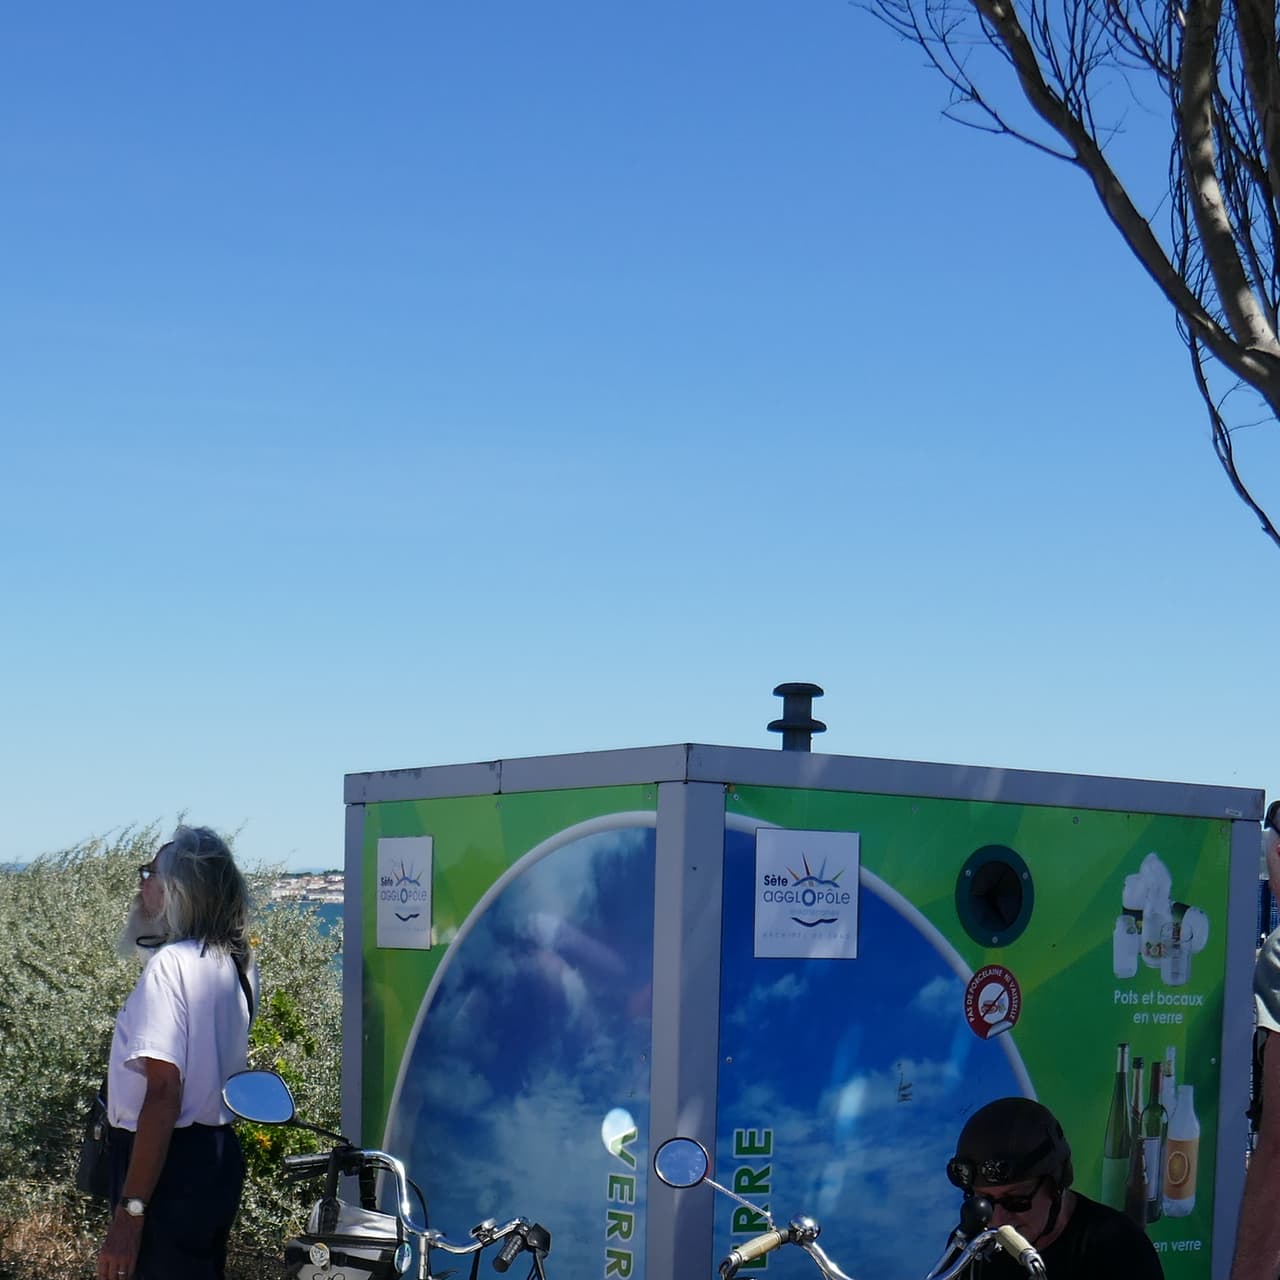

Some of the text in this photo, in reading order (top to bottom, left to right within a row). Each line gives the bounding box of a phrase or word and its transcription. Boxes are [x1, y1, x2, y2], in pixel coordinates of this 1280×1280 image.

[763, 874, 788, 887] Sète
[1114, 990, 1204, 1006] Pots et bocaux
[1133, 1013, 1184, 1024] en verre
[1154, 1240, 1202, 1252] en verre
